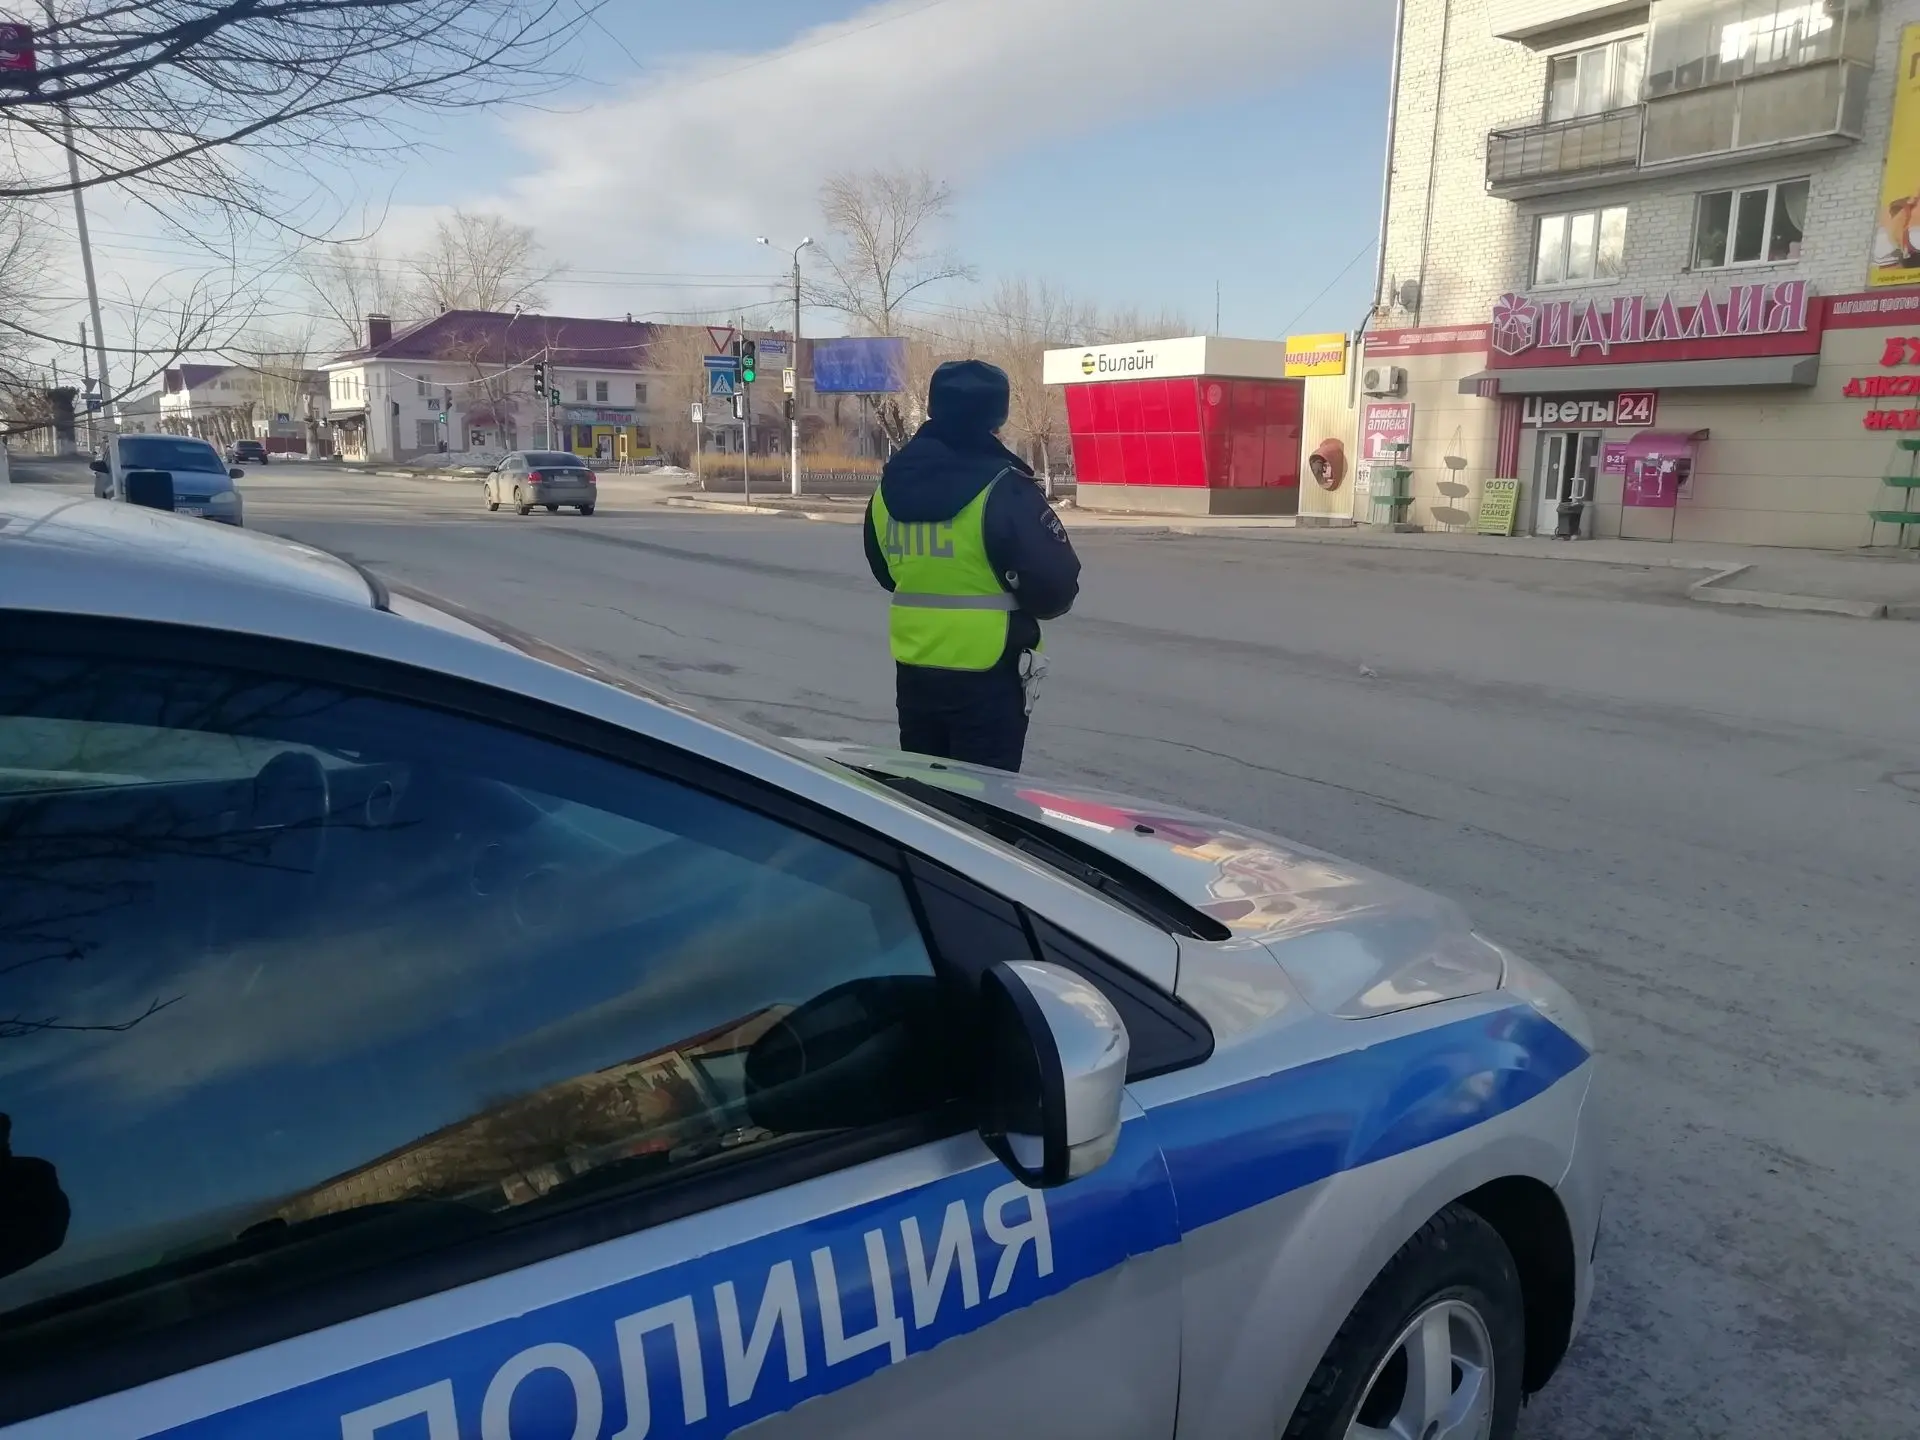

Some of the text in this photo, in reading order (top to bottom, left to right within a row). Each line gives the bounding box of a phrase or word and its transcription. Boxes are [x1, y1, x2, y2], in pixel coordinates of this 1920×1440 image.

[1537, 279, 1808, 357] ИДИЛЛИЯ
[1098, 350, 1154, 373] Билайн
[1618, 397, 1650, 420] 24
[1486, 481, 1515, 490] ФОТО
[1480, 509, 1511, 517] СКАНЕР
[886, 514, 954, 561] ДПС
